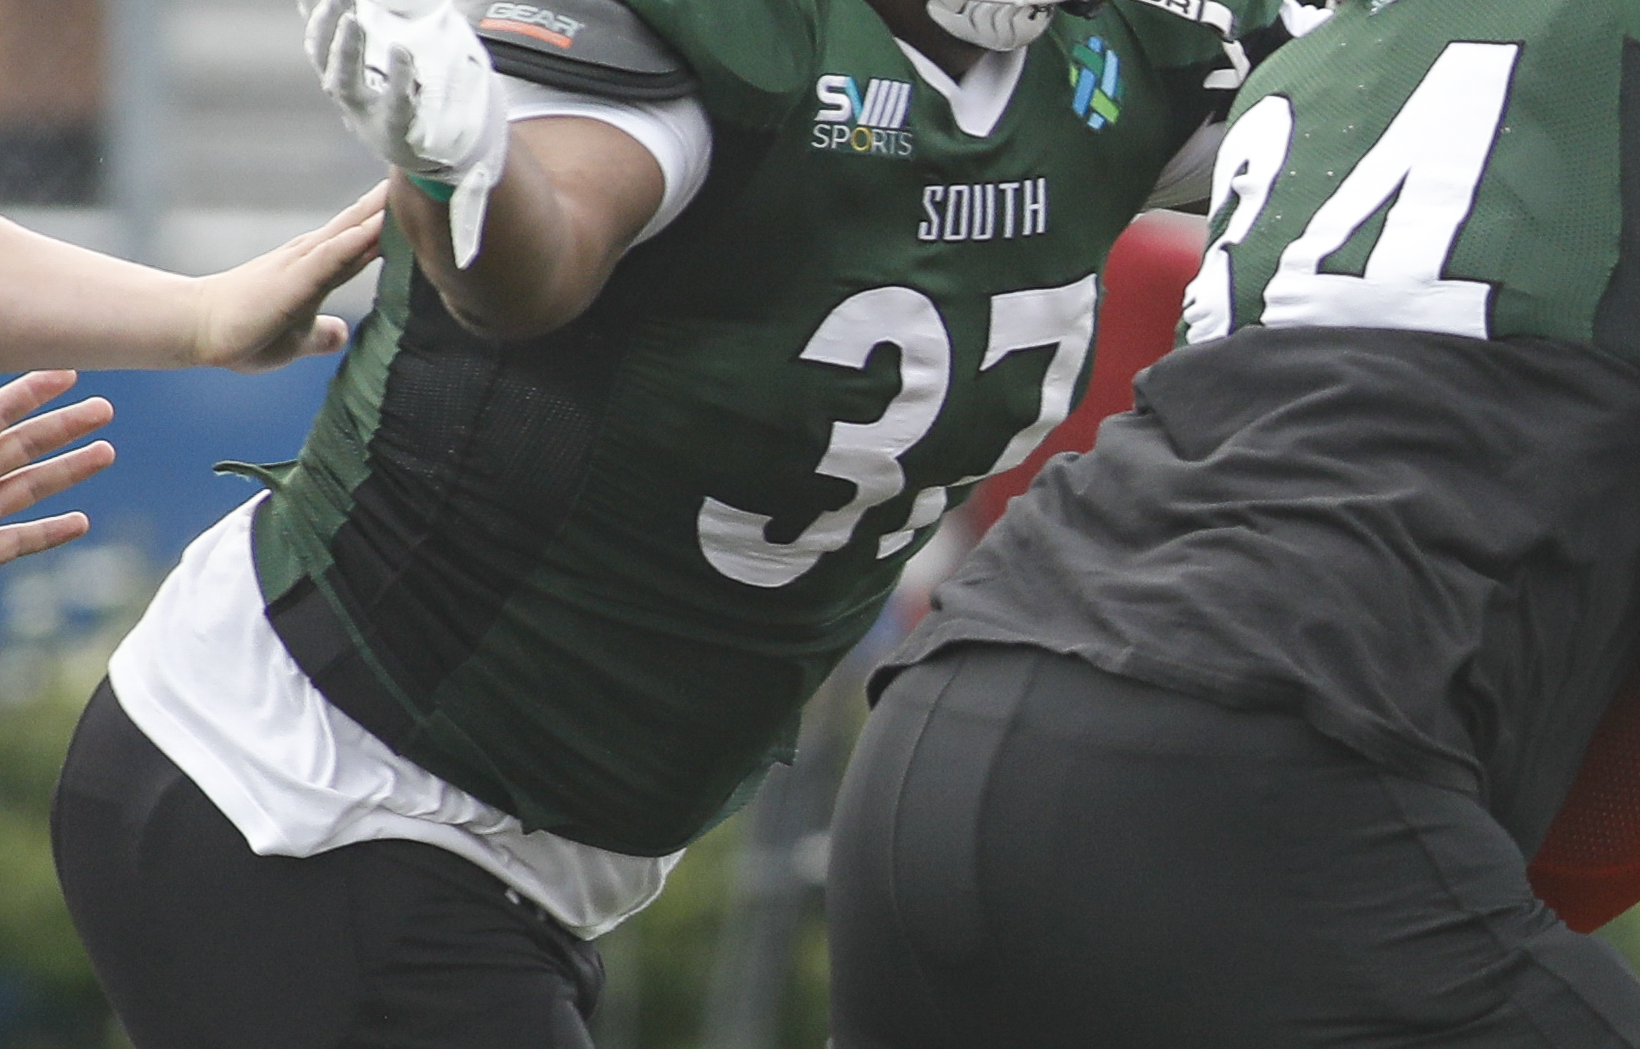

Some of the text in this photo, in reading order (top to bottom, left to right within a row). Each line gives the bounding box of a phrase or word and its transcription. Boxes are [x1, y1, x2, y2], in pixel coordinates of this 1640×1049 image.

[485, 1, 580, 38] GEAR
[810, 122, 913, 156] SPORTS
[917, 176, 1047, 242] SOUTH
[696, 273, 1097, 588] 37
